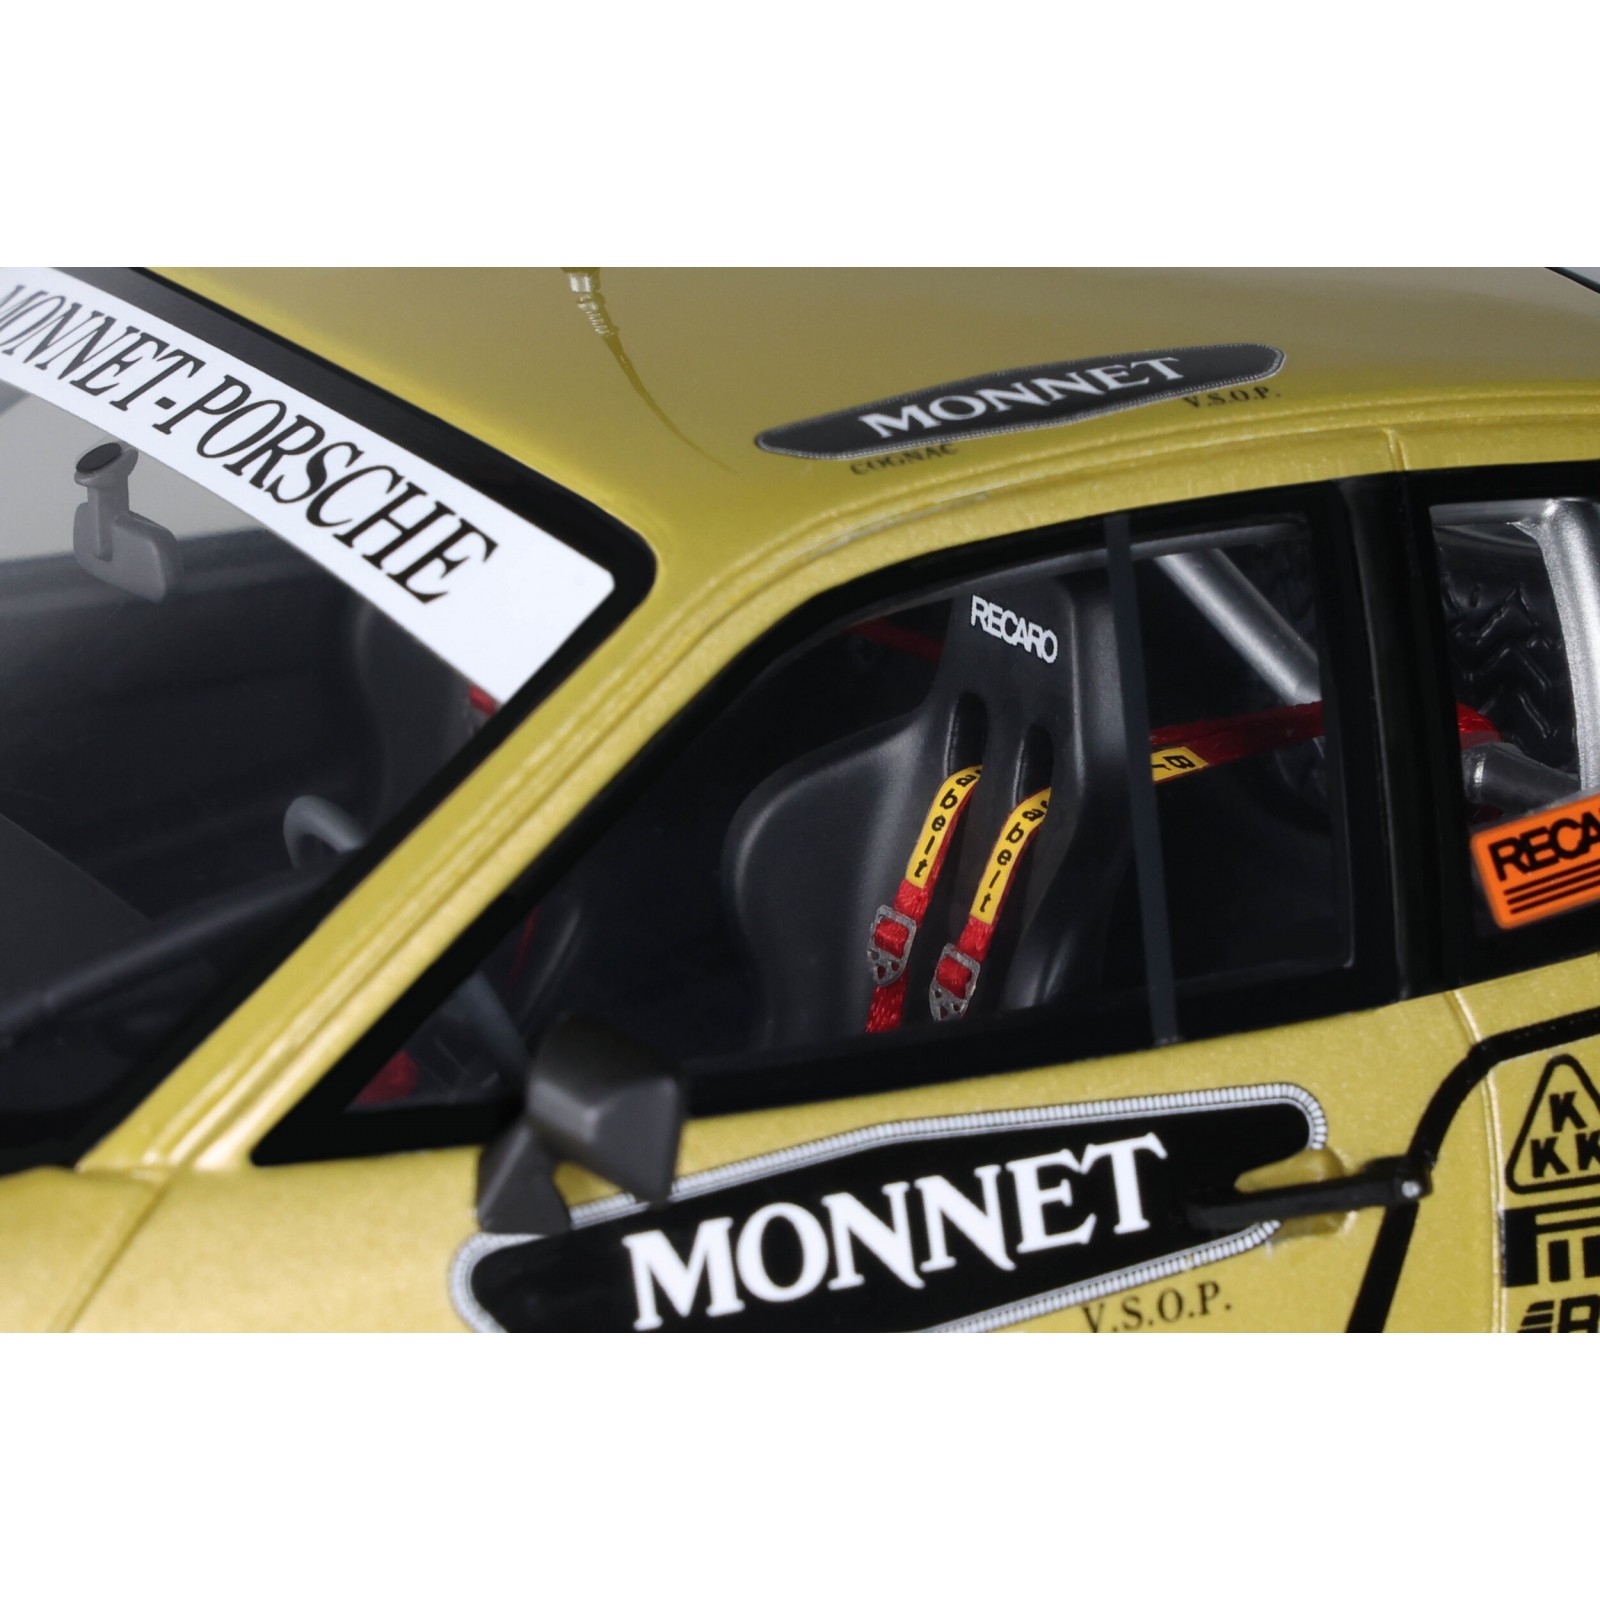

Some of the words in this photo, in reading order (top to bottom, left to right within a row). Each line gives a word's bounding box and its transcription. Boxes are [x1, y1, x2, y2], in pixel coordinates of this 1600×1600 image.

[858, 355, 1184, 439] MONNET
[1182, 384, 1281, 410] V.S.O.P.
[850, 443, 959, 476] COGNAC
[970, 594, 1059, 664] RECARO
[913, 769, 982, 880] abelt
[978, 800, 1049, 914] abelt
[1488, 807, 1600, 881] RECA
[622, 1132, 1168, 1332] MONNET
[1081, 1280, 1233, 1333] V.S.O.P.
